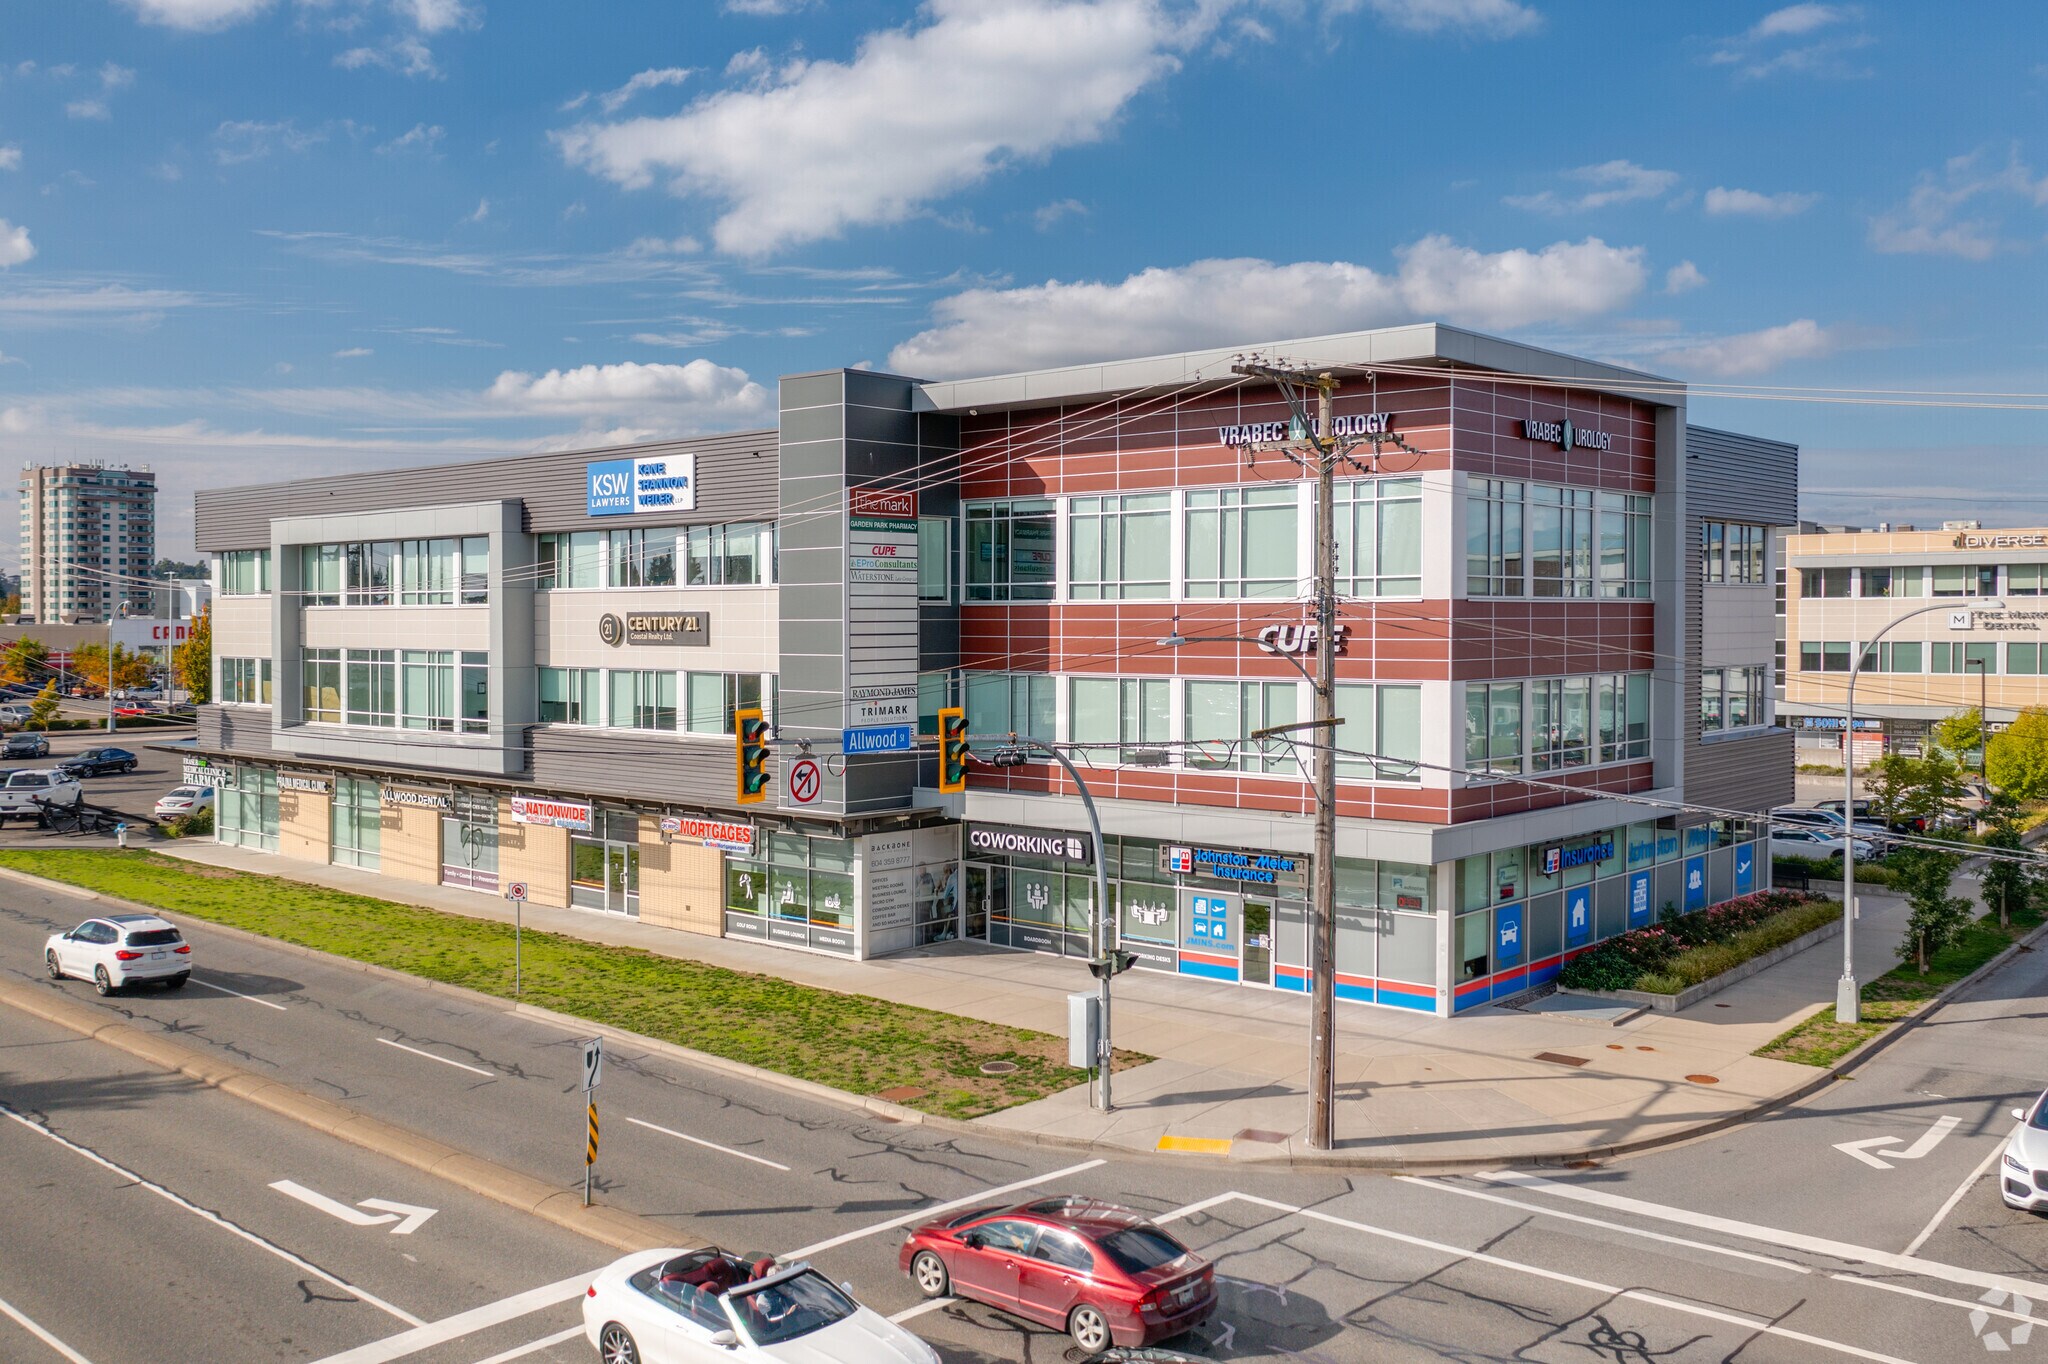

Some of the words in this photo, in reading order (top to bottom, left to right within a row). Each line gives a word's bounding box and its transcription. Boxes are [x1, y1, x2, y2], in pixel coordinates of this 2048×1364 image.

[1219, 422, 1283, 445] VRABEC
[1525, 420, 1561, 442] VRABEC
[1575, 428, 1612, 450] UROLOGY
[638, 463, 665, 475] KANE
[593, 473, 629, 496] KSW
[638, 477, 688, 490] SHANNON
[591, 497, 630, 507] LAWYERS
[638, 493, 674, 505] WEILER
[860, 496, 879, 510] the
[880, 498, 909, 512] mark
[850, 520, 873, 528] GARDEN
[873, 521, 888, 529] PARK
[889, 522, 918, 530] PHARMACY
[1966, 535, 2045, 546] DIVERSE
[872, 546, 897, 556] CUPE
[1954, 616, 1964, 624] M
[1974, 611, 2004, 619] THE
[628, 616, 683, 631] CENTURY
[1984, 622, 2041, 630] DENTAL
[649, 633, 663, 641] Realty
[852, 688, 890, 698] RAYMOND
[891, 687, 916, 697] JAMES
[861, 705, 908, 716] TRIMARK
[849, 730, 897, 750] Allwood
[183, 773, 227, 788] PHARMACY
[381, 790, 417, 803] ALLWOOD
[418, 795, 448, 807] DENTAL
[526, 801, 586, 820] NATIONWIDE
[680, 820, 751, 843] MORTGAGES
[871, 841, 911, 852] BACKBONE
[970, 831, 1063, 856] COWORKING
[1561, 840, 1614, 865] Insurance
[871, 859, 882, 868] 604
[883, 857, 895, 865] 359
[896, 856, 910, 864] 8777
[1194, 849, 1249, 865] Johnston
[1255, 855, 1295, 871] Meier
[1213, 865, 1274, 882] Insurance
[773, 928, 790, 936] BUSINESS
[791, 931, 806, 939] LOUNGE
[831, 938, 846, 946] BOOTH
[1023, 935, 1052, 945] BOARDROOM
[1186, 937, 1235, 951] JMINS.com
